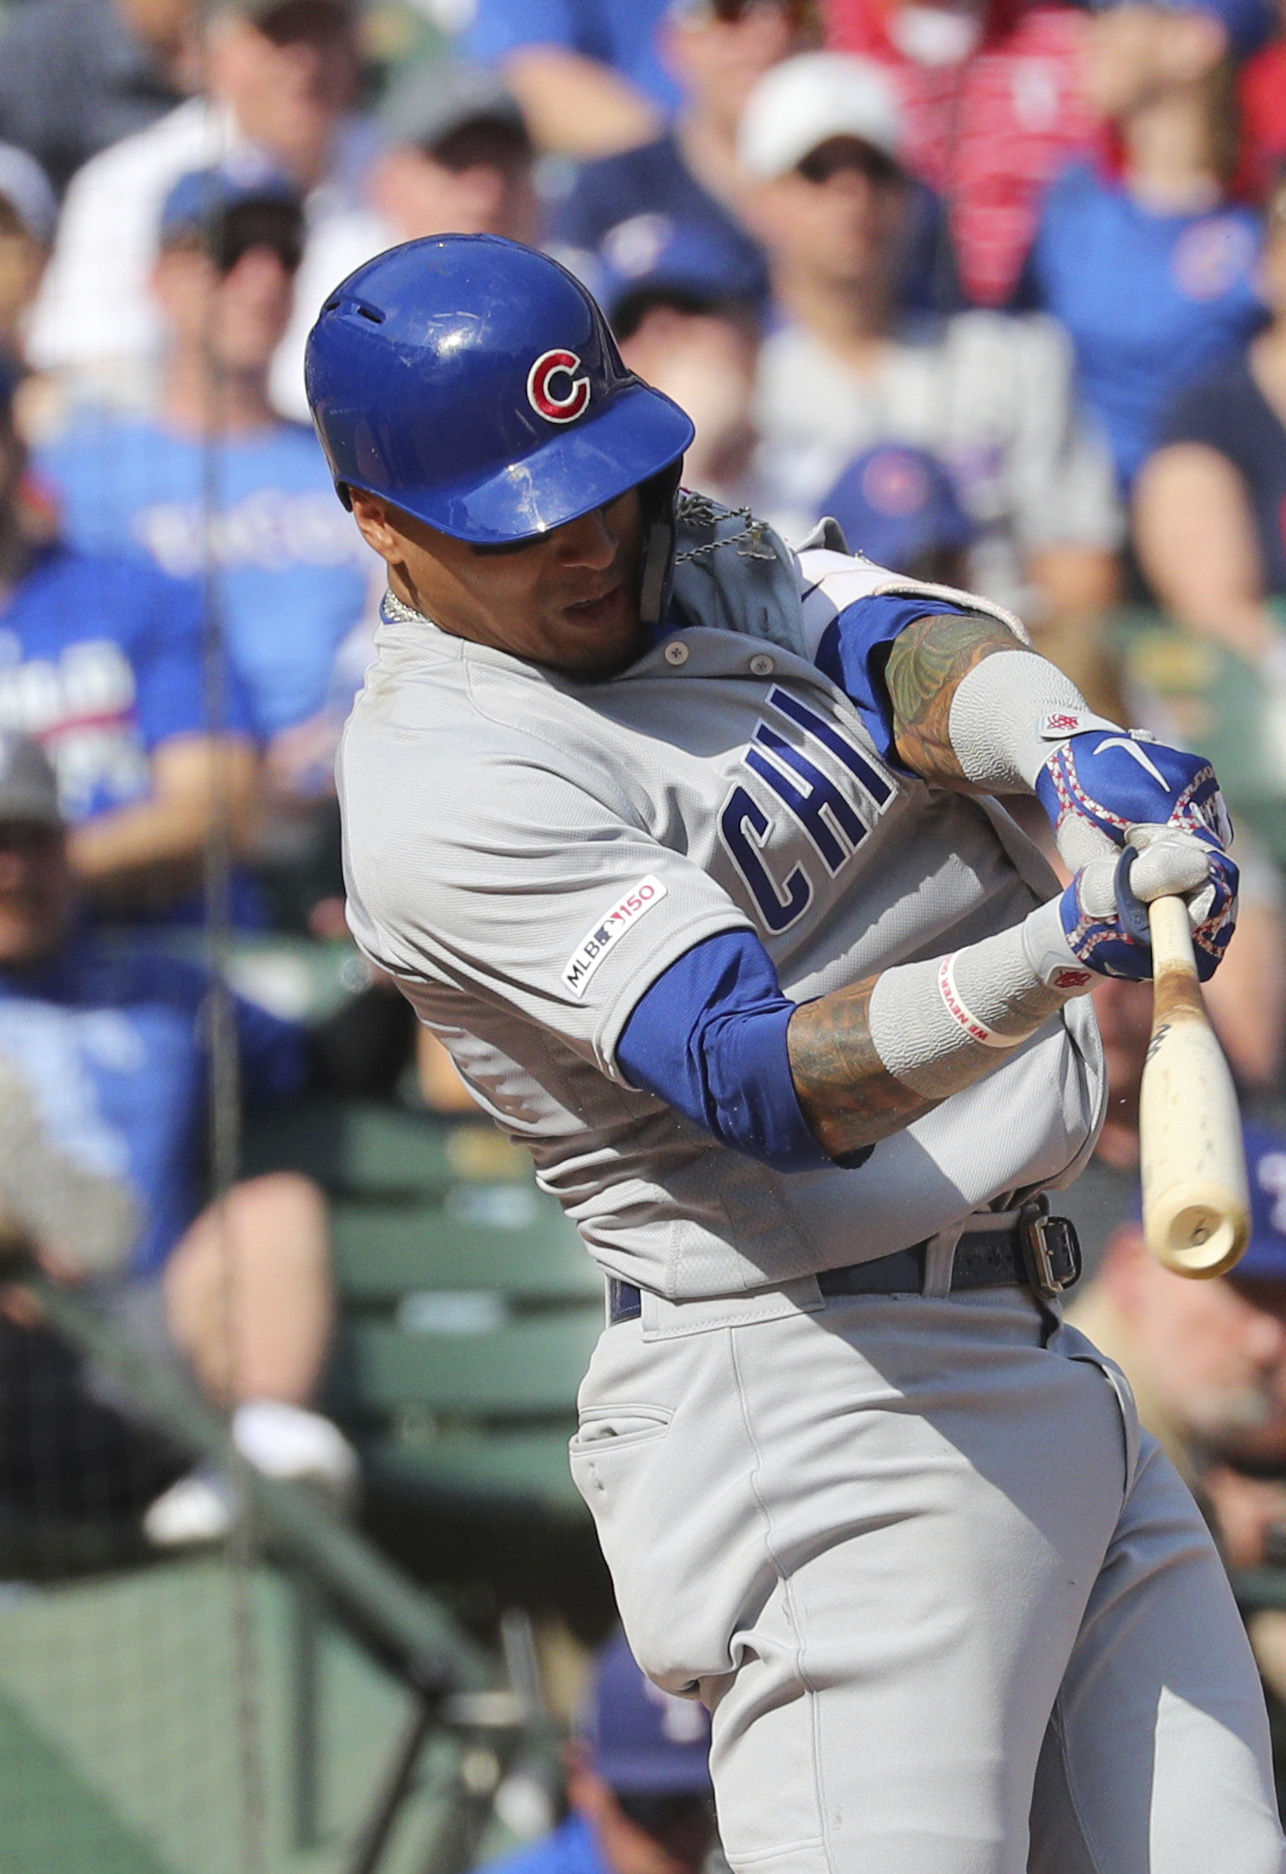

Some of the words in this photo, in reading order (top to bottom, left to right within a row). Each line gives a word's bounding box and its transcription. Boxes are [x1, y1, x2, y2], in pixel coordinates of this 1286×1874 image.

[527, 348, 591, 423] C
[717, 683, 899, 935] CHI
[566, 940, 601, 989] MLB
[619, 884, 655, 917] 150
[940, 977, 969, 1025] NEVER
[967, 1023, 988, 1041] WE
